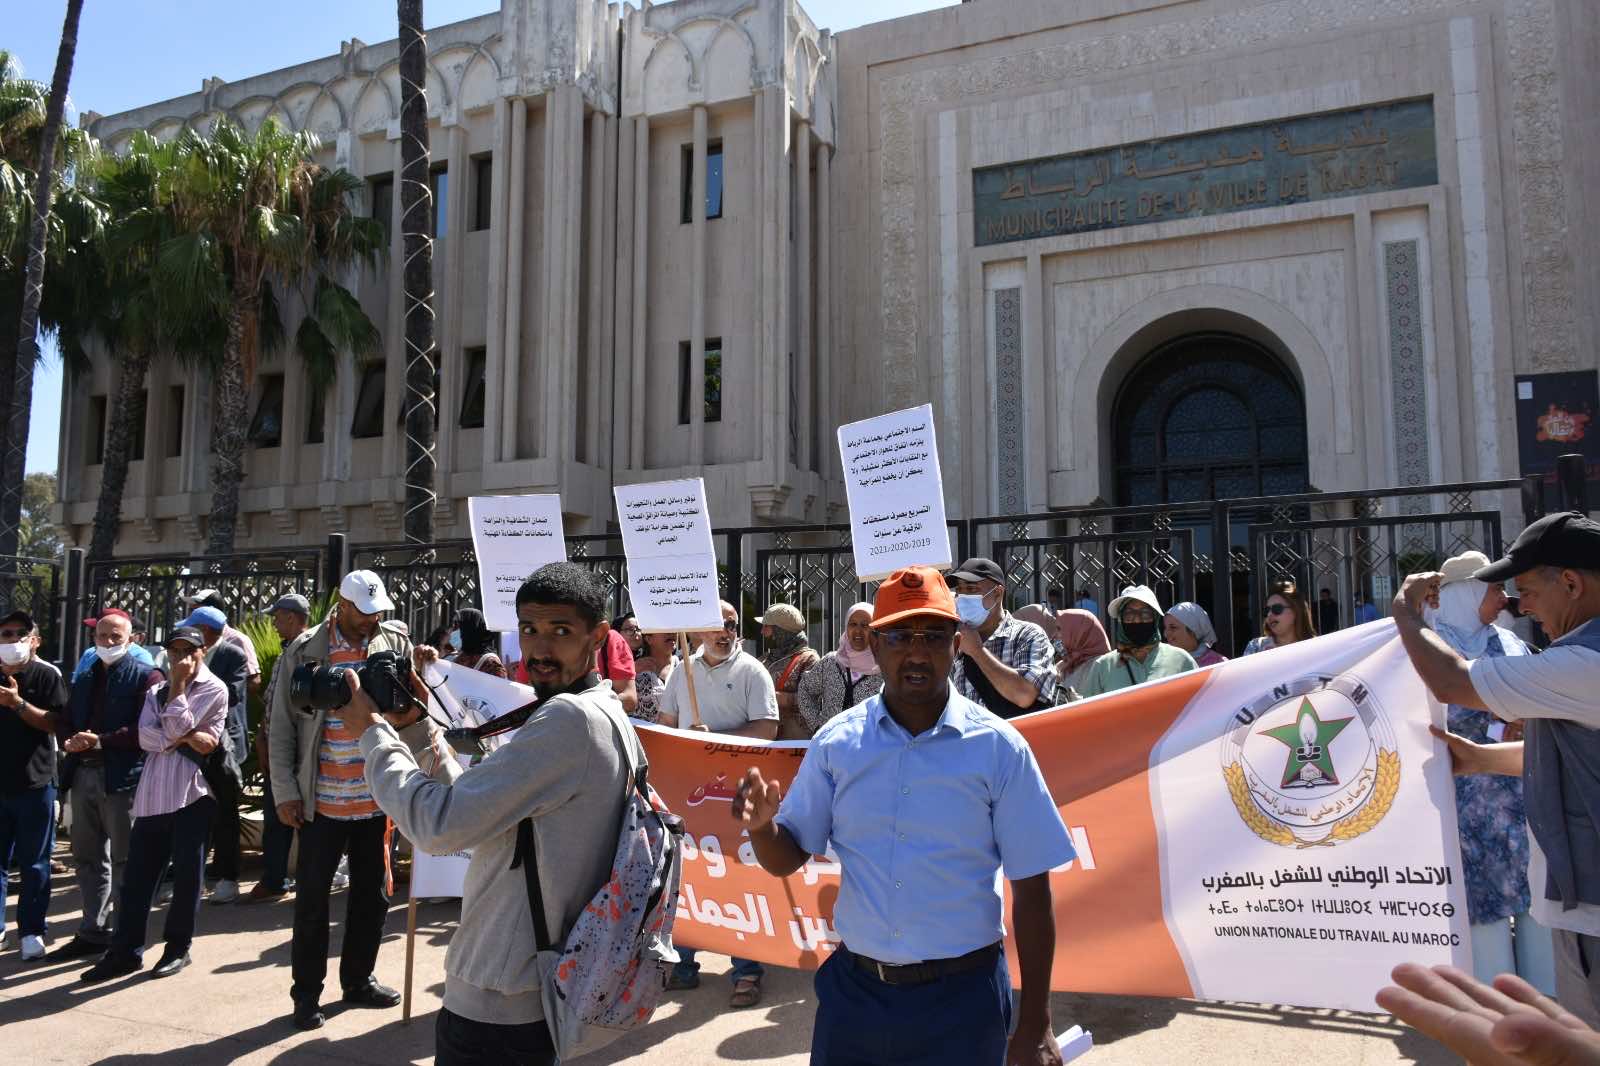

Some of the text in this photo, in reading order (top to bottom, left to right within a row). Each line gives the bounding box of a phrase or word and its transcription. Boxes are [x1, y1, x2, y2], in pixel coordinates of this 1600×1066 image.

[1000, 159, 1113, 201] الرباط
[1121, 144, 1264, 180] مدينة
[1136, 192, 1166, 218] DE
[1175, 188, 1201, 214] LA
[1211, 177, 1266, 208] VILLE
[1279, 174, 1308, 199] DE
[1320, 160, 1400, 193] RABAT
[1201, 865, 1452, 893] الاتحاد الوطني للشغل بالمغرب
[1214, 926, 1460, 947] UNION NATIONALE DU TRAVAIL AU MAROC
